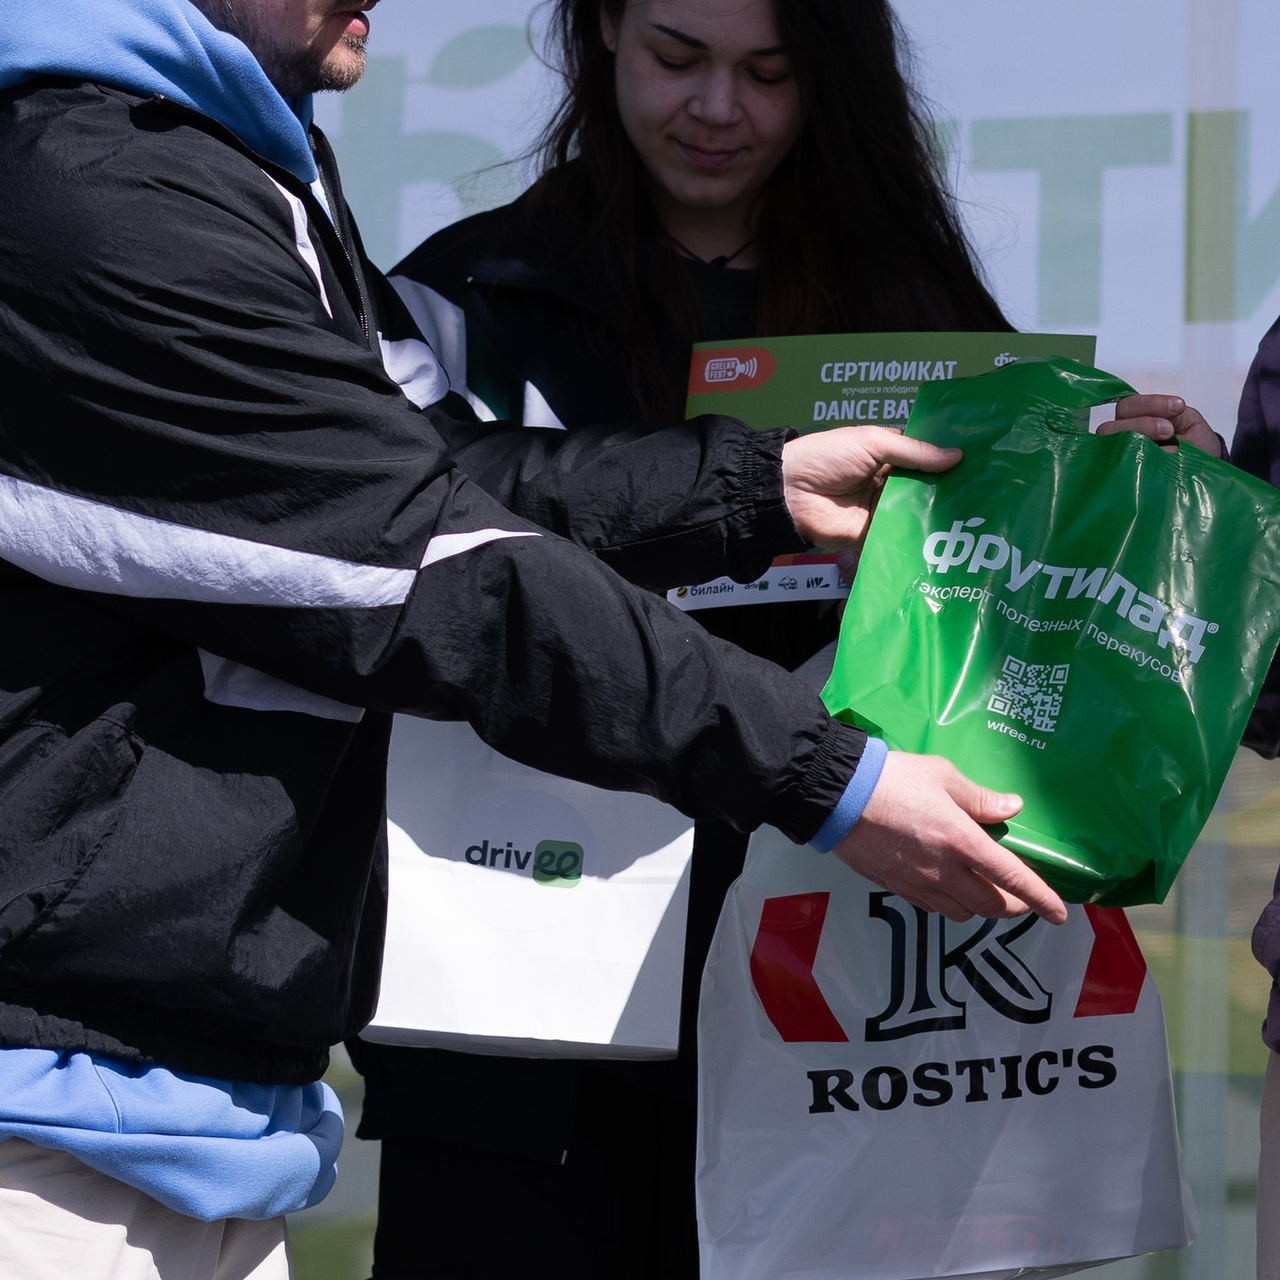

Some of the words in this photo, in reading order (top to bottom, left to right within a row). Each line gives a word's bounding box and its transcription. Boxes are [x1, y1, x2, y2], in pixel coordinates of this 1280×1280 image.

[709, 369, 728, 380] FEST
[820, 360, 958, 383] СЕРТИФИКАТ
[813, 399, 882, 422] DANCE
[690, 582, 734, 596] билайн
[919, 581, 994, 603] эксперт
[996, 599, 1084, 633] полезных
[1087, 623, 1186, 683] перекусов
[987, 719, 1047, 750] wtree.ru
[807, 1044, 1118, 1114] ROSTIC'S
